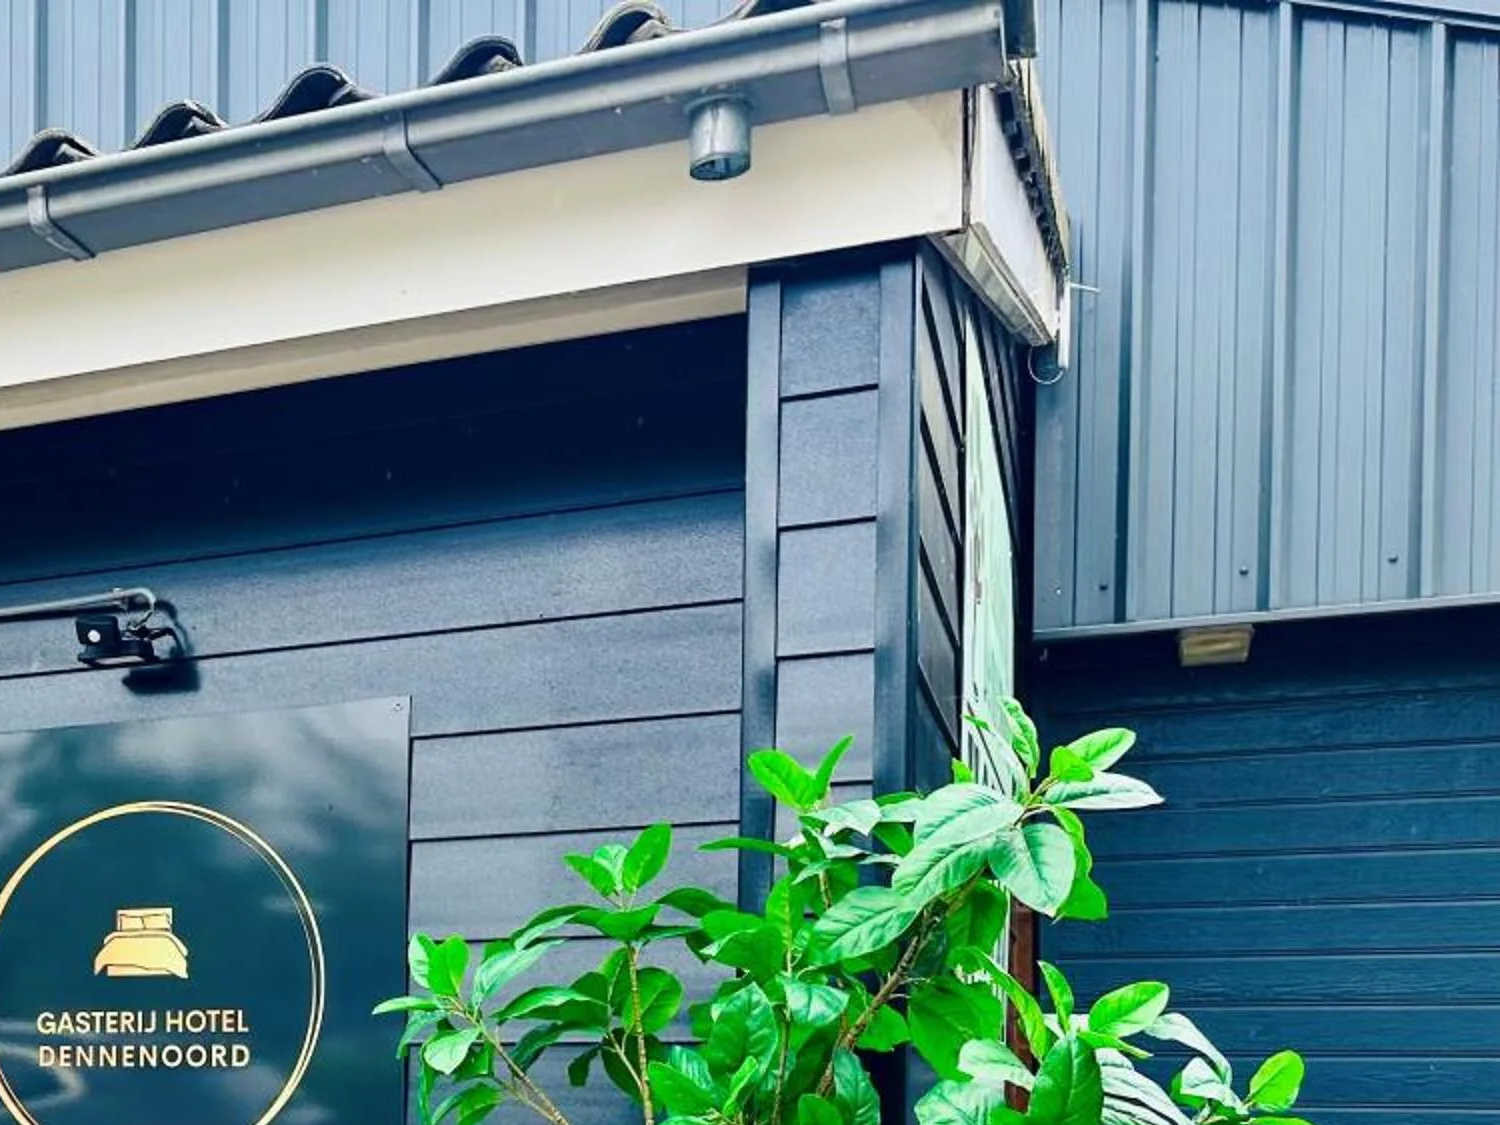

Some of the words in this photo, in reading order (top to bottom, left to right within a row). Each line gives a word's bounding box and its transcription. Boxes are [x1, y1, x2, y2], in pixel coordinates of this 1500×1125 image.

[36, 1010, 157, 1035] GASTERIJ
[165, 1009, 249, 1033] HOTEL
[38, 1044, 251, 1068] DENNENOORD
